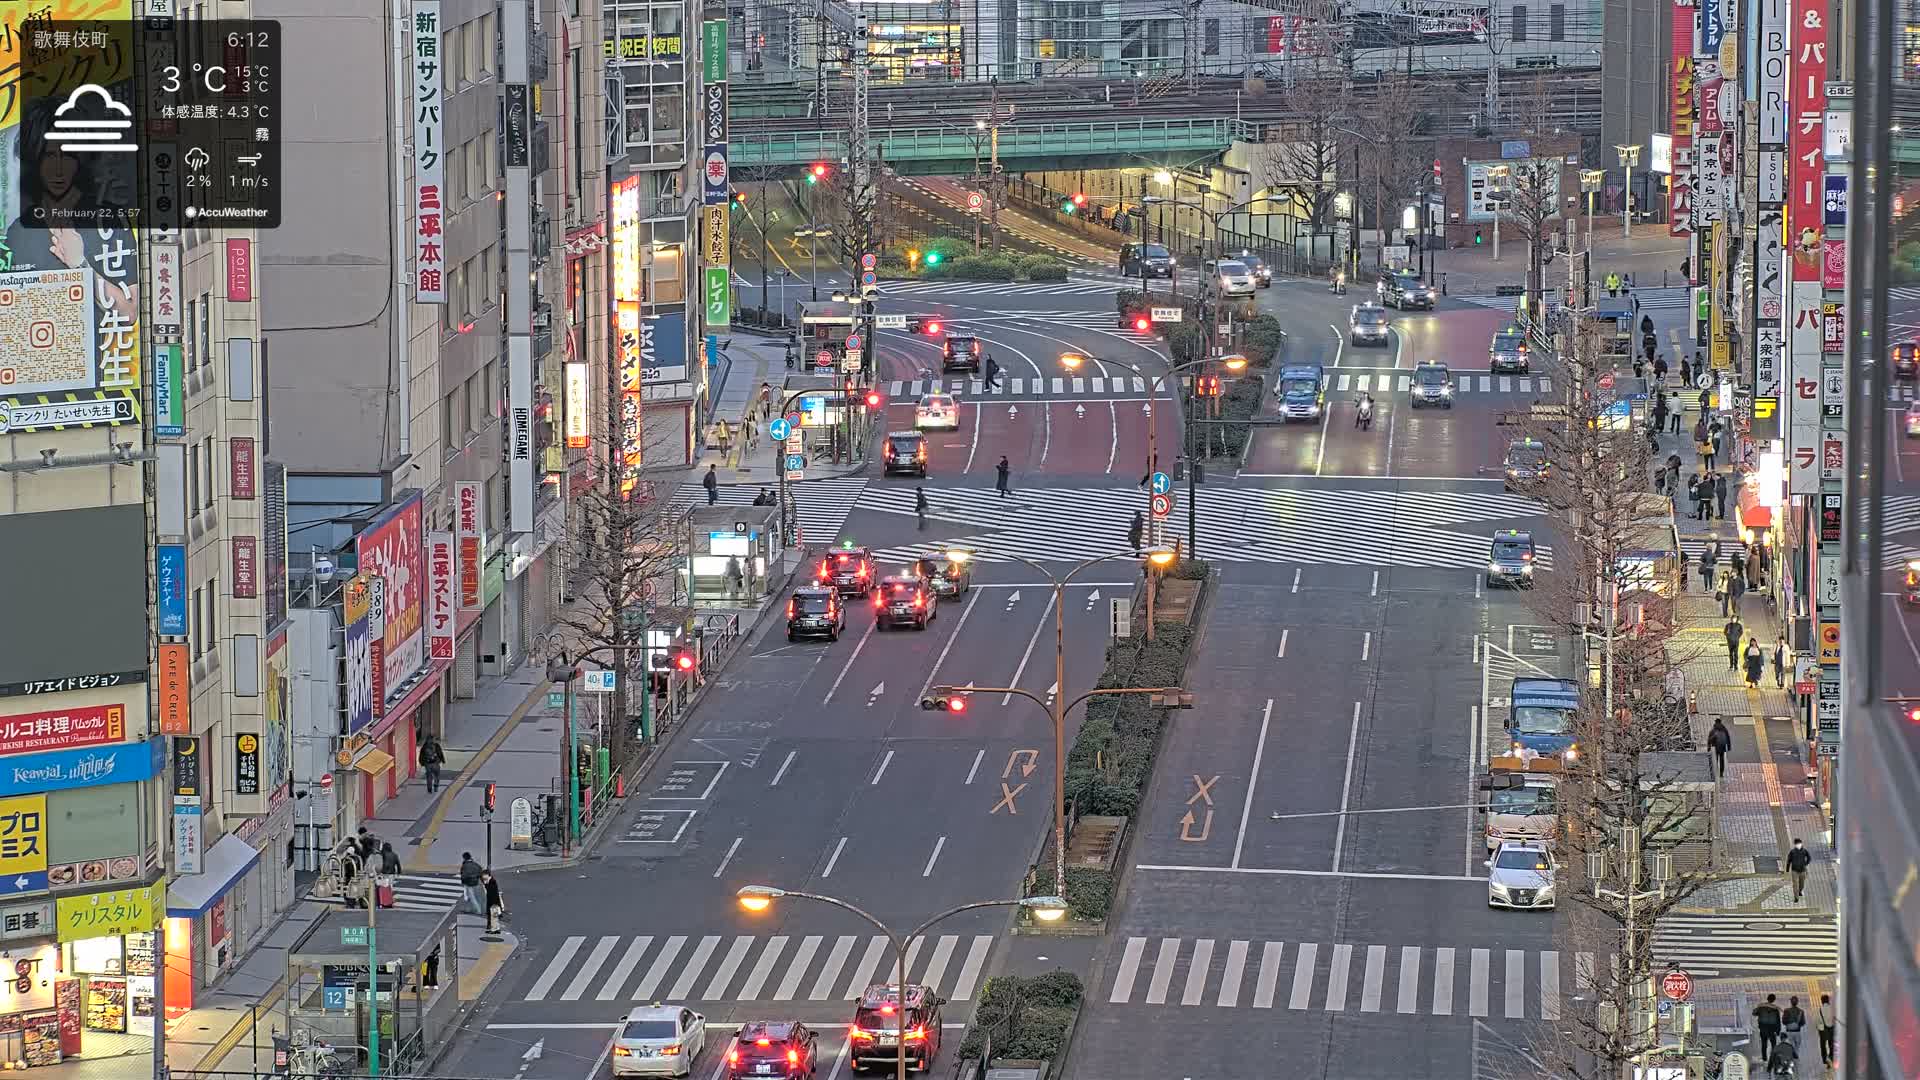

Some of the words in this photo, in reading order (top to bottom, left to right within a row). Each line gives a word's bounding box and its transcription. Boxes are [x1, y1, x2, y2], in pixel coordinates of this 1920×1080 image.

[416, 12, 439, 170] 新宿サンパーク
[1675, 55, 1693, 136] パチンコ
[1706, 88, 1717, 120] アコム
[709, 86, 722, 138] もつなべ
[1706, 122, 1717, 130] 3F
[708, 161, 724, 177] 薬
[1673, 148, 1692, 233] エスパス
[418, 185, 441, 292] 三平本館
[711, 208, 723, 263] 肉汁水餃子
[710, 276, 723, 314] レイク
[1825, 304, 1834, 312] 6F
[158, 325, 175, 334] 3F
[1760, 331, 1773, 383] 大衆酒場
[157, 354, 169, 415] FamilyMart
[1795, 309, 1820, 469] パセラ
[14, 410, 49, 422] テンクリ
[54, 404, 112, 419] たいせい先生
[1828, 405, 1841, 415] 5F
[514, 408, 528, 460] HOMEGAME
[461, 488, 472, 531] GAME
[1828, 497, 1839, 506] 3F
[161, 555, 172, 606] ゲウチャイ
[432, 542, 449, 629] 三平ストア
[373, 581, 382, 619] 389
[24, 674, 120, 694] リアエイドビジョン
[110, 711, 120, 736] 5F
[26, 735, 70, 748] RESTAURANT
[242, 736, 254, 751] 占
[0, 811, 40, 836] プロ
[0, 836, 40, 858] ミス
[5, 911, 39, 932] 囲碁
[70, 903, 143, 928] クリスタル
[327, 991, 342, 1004] 12
